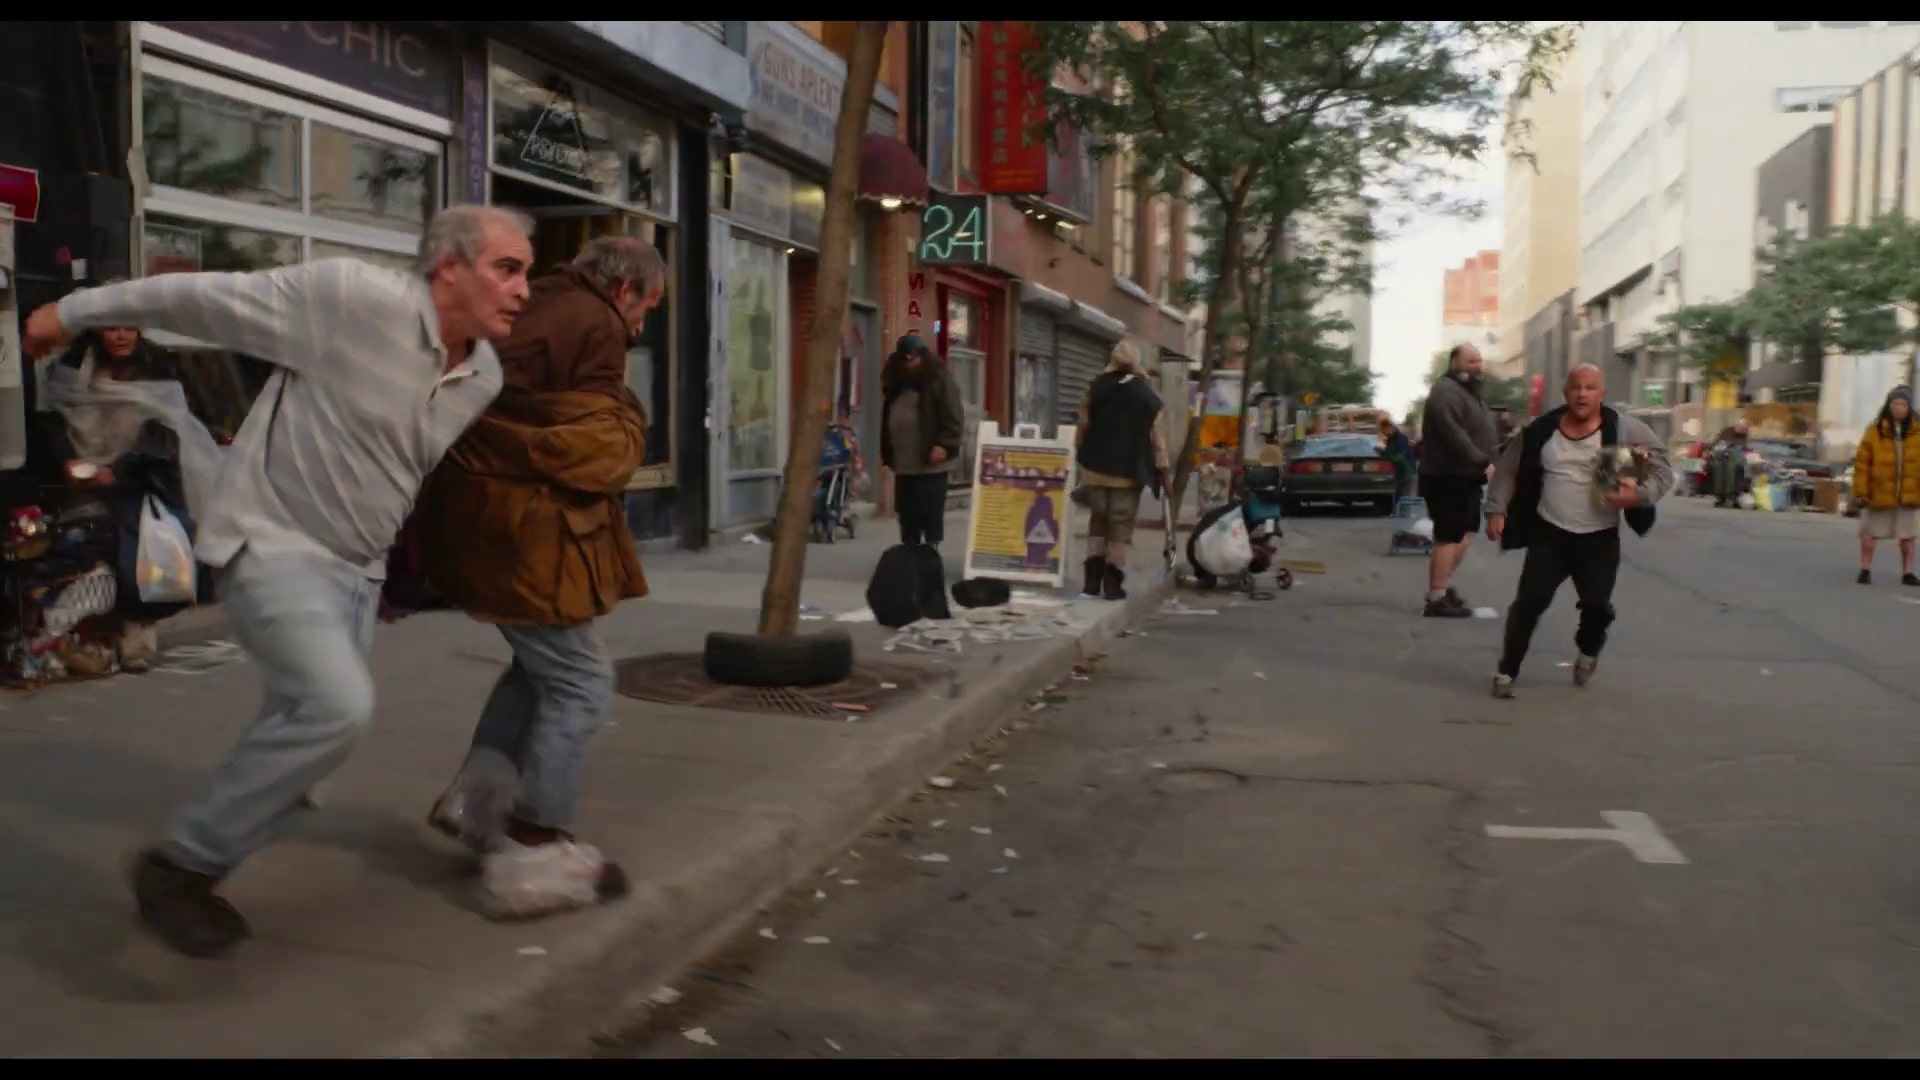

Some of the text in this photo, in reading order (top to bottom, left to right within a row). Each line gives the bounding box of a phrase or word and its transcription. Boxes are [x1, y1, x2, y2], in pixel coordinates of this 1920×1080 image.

[763, 41, 796, 90] GUNS
[469, 110, 481, 198] TAROT
[920, 204, 984, 261] 24
